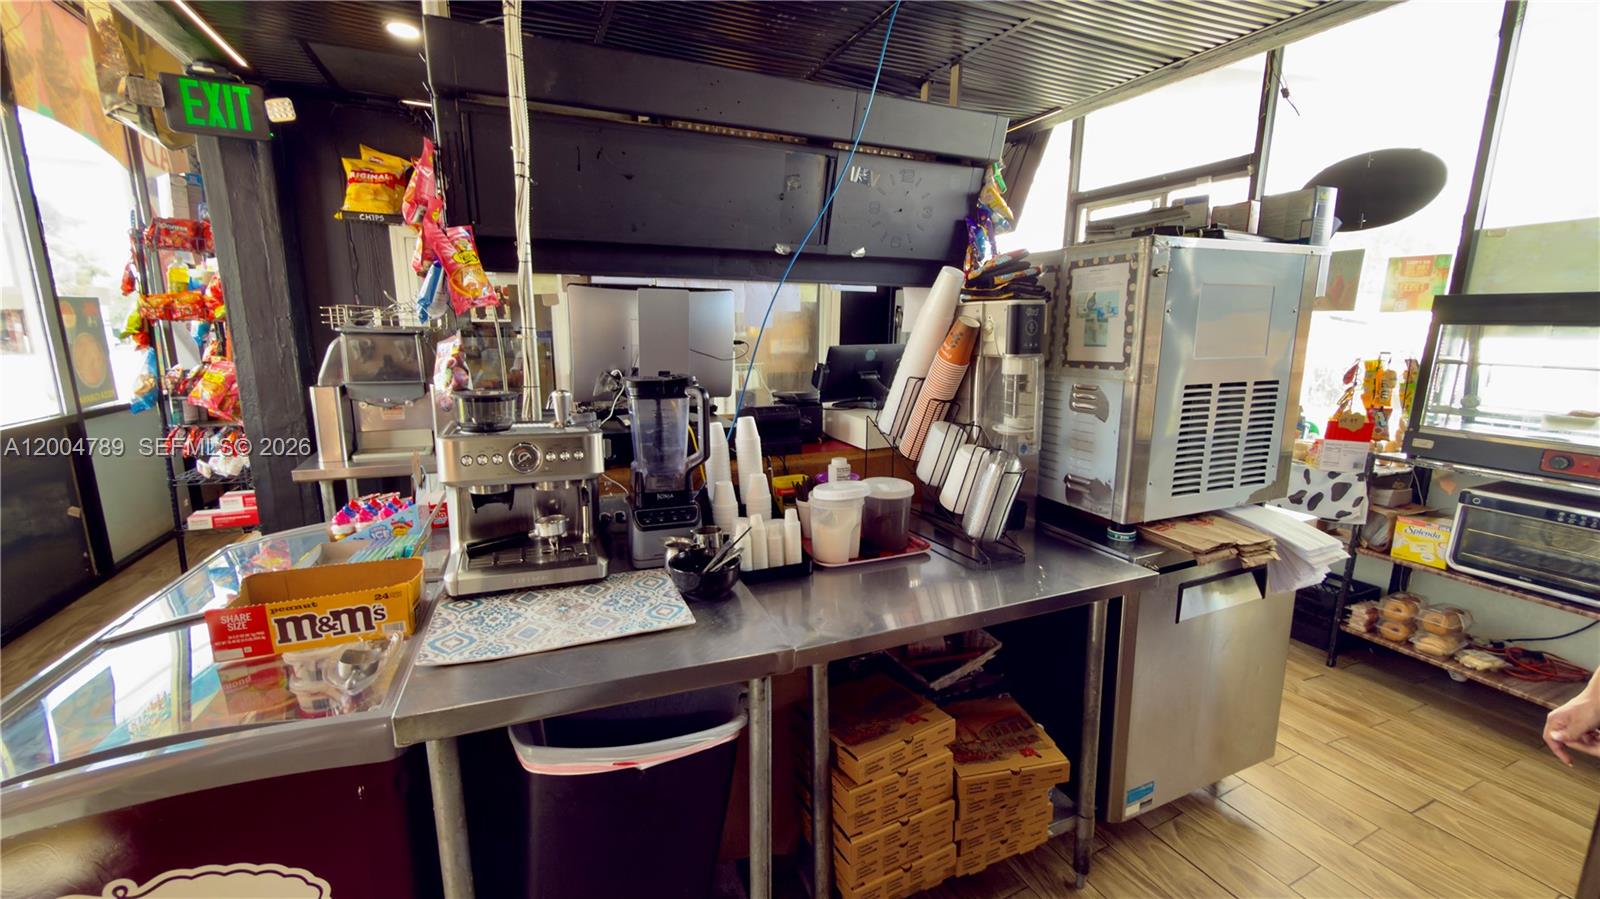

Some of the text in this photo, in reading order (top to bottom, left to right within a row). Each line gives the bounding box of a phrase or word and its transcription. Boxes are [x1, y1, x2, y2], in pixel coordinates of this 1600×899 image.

[178, 77, 252, 131] EXIT
[359, 213, 385, 222] CHIPS
[1404, 525, 1442, 540] Splenda
[374, 593, 389, 601] 24
[270, 601, 318, 615] peanut
[220, 612, 252, 625] SHARE
[273, 604, 387, 645] m&m's
[227, 621, 248, 632] SIZE
